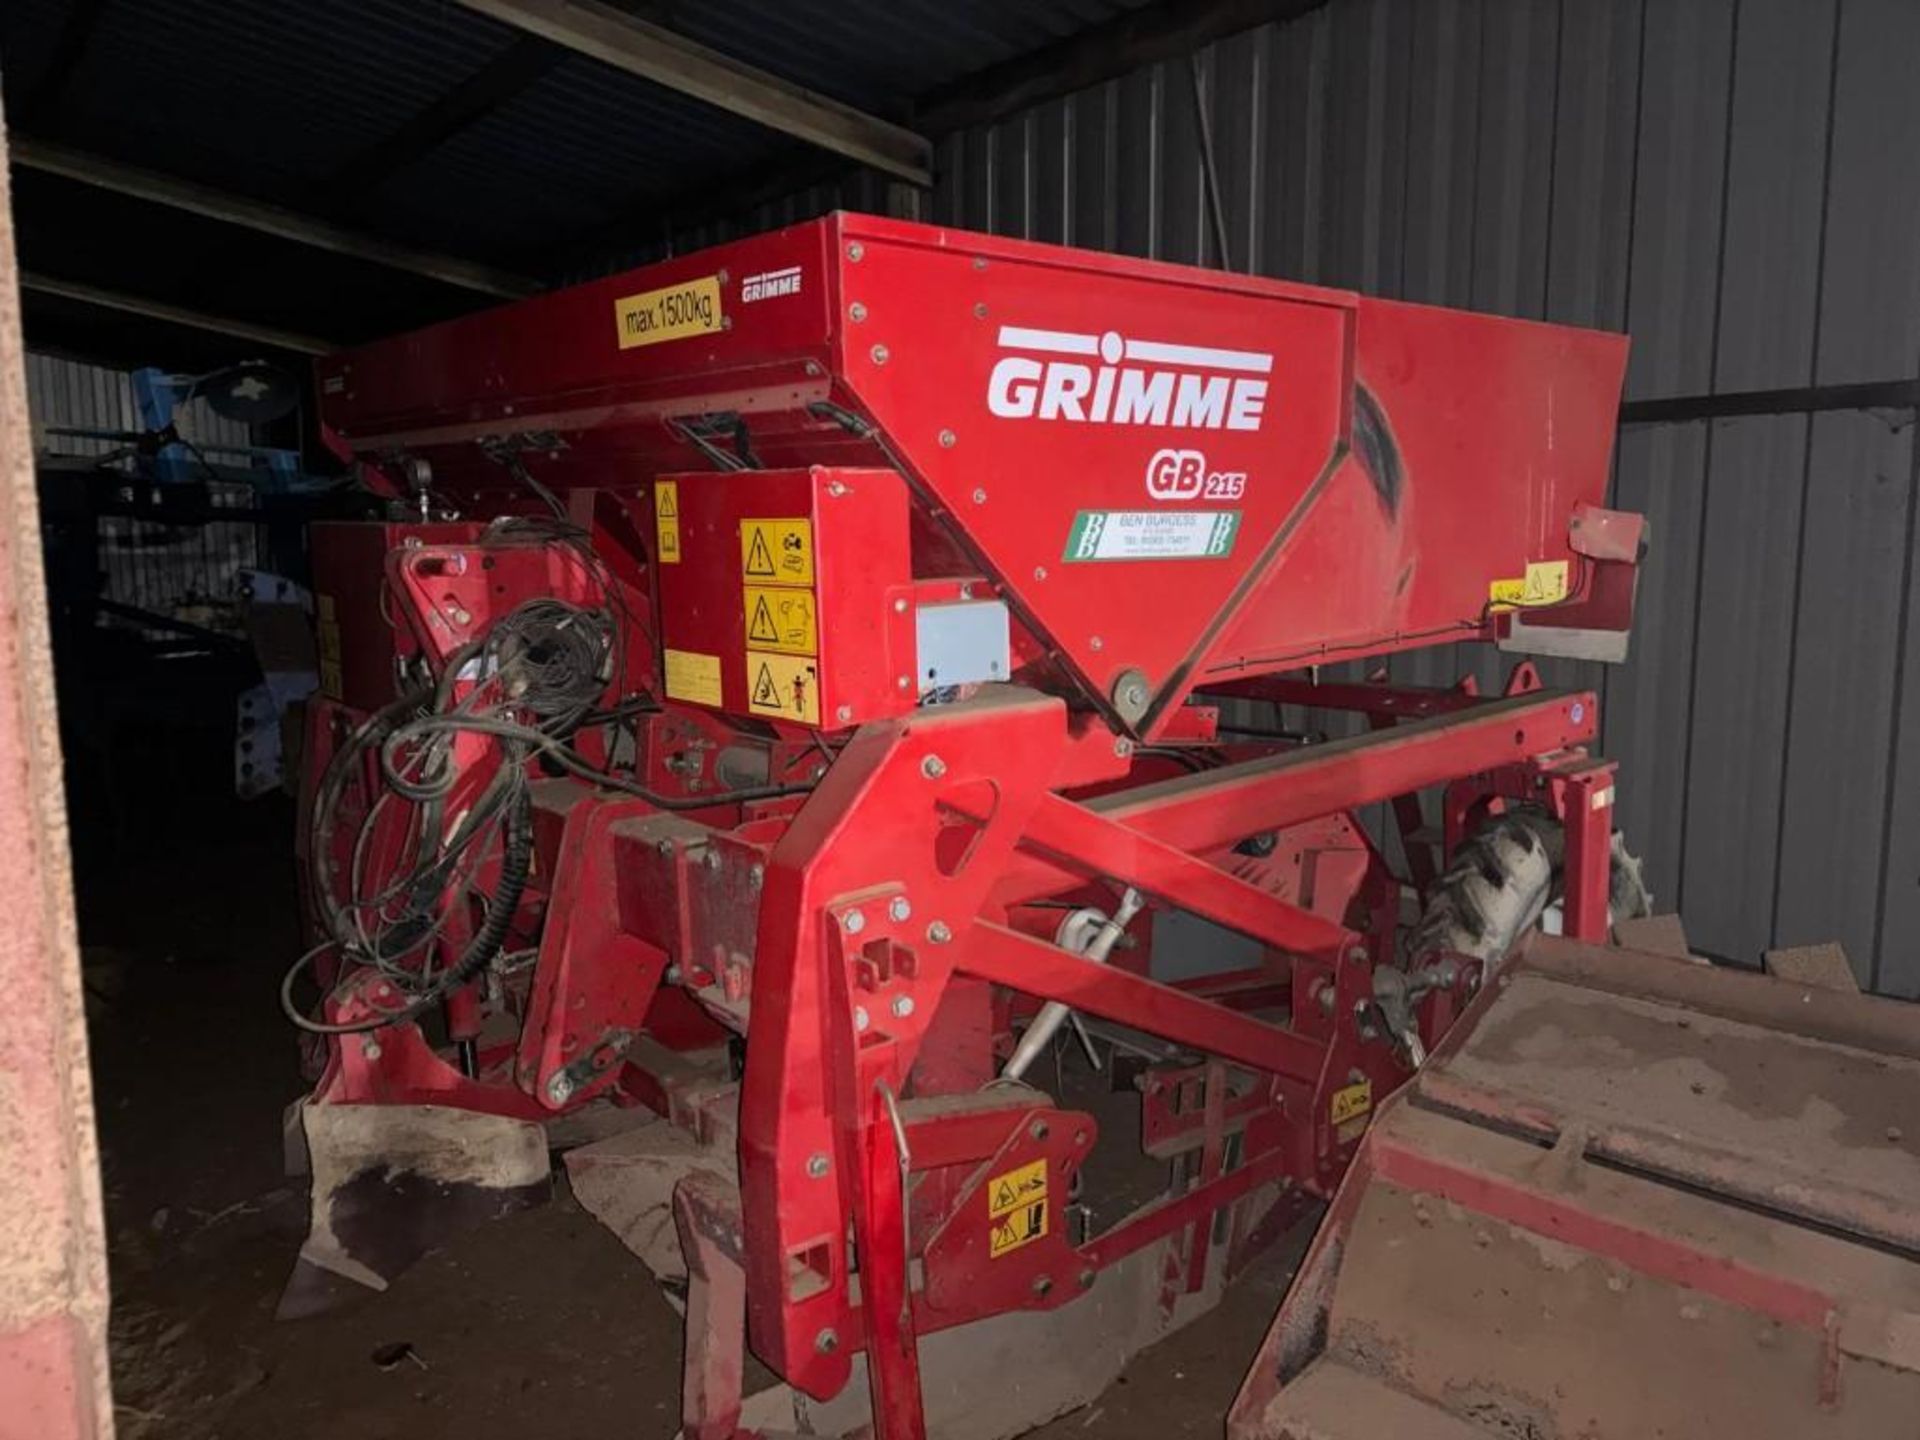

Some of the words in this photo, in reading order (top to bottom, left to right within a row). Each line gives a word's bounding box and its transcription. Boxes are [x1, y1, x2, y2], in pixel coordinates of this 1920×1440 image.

[741, 272, 802, 303] GRIMME
[987, 331, 1269, 431] GRIMME
[1149, 452, 1204, 496] GB
[1206, 475, 1245, 498] 215
